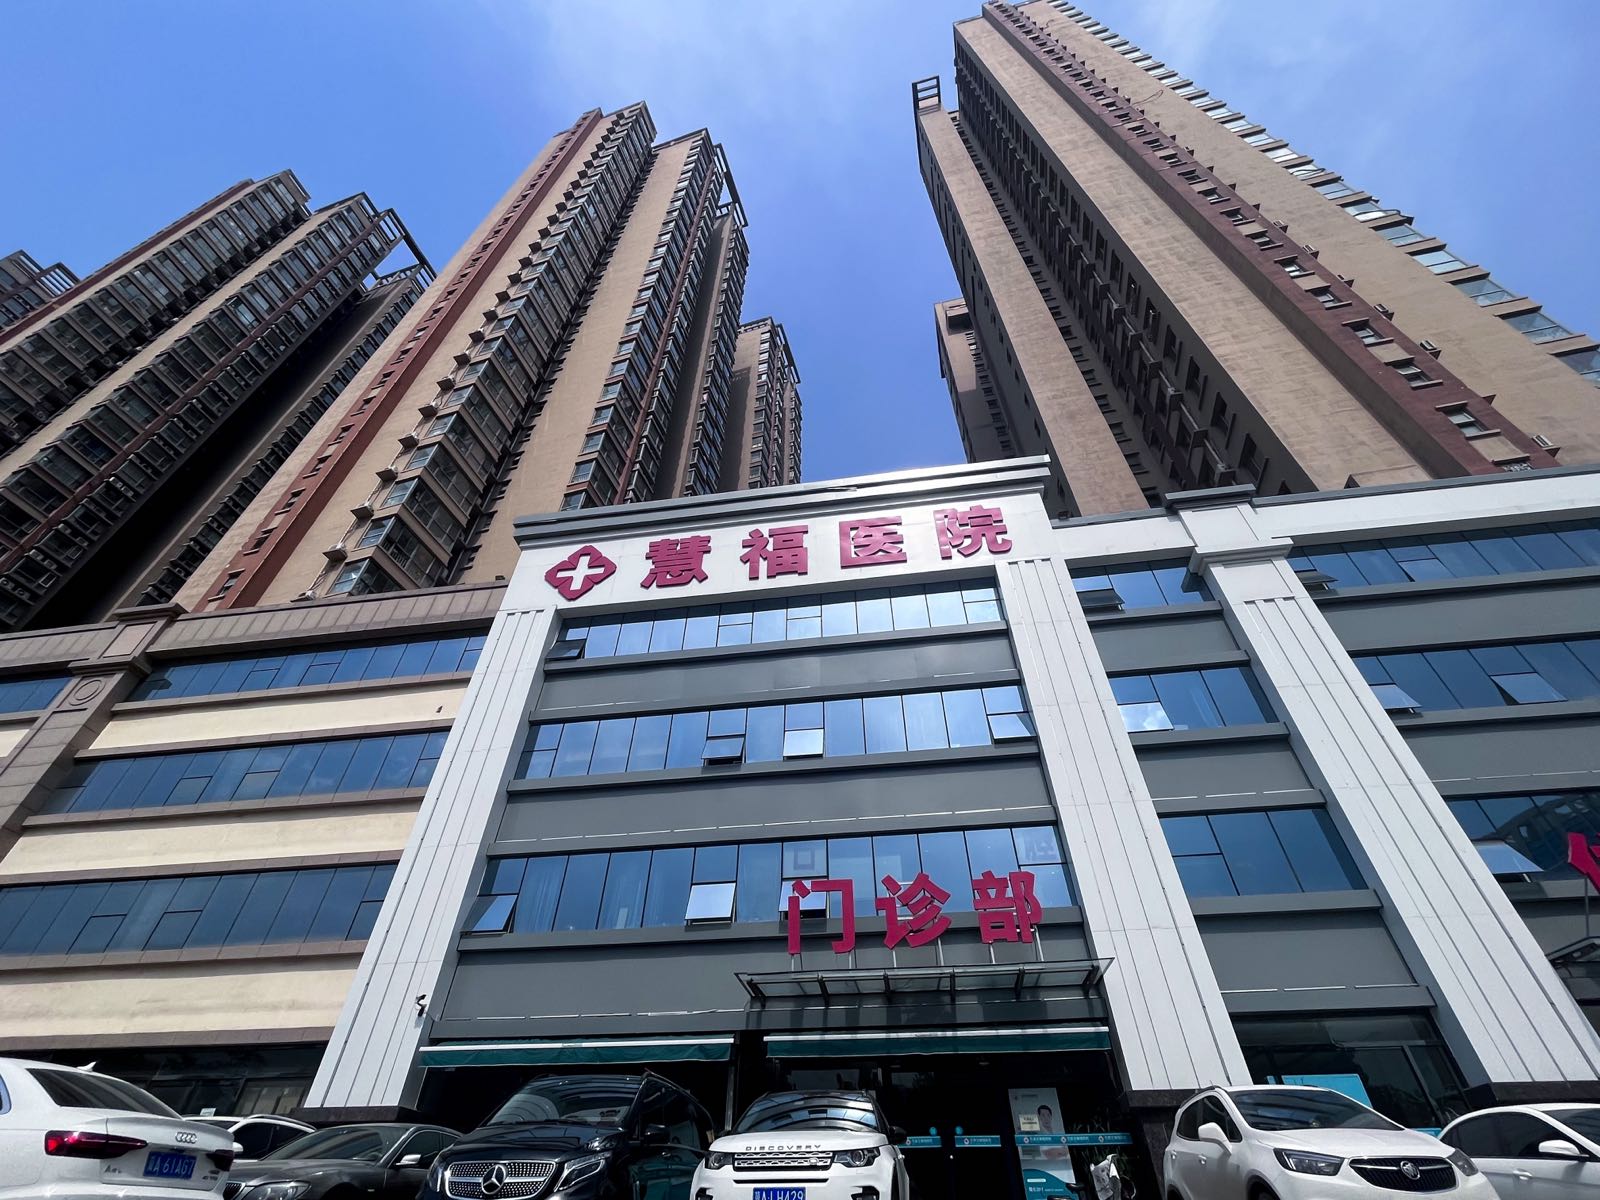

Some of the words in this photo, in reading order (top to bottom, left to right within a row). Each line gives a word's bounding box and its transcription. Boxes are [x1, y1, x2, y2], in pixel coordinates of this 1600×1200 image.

[641, 505, 1010, 588] 慧福医院
[787, 870, 1042, 955] 门诊部
